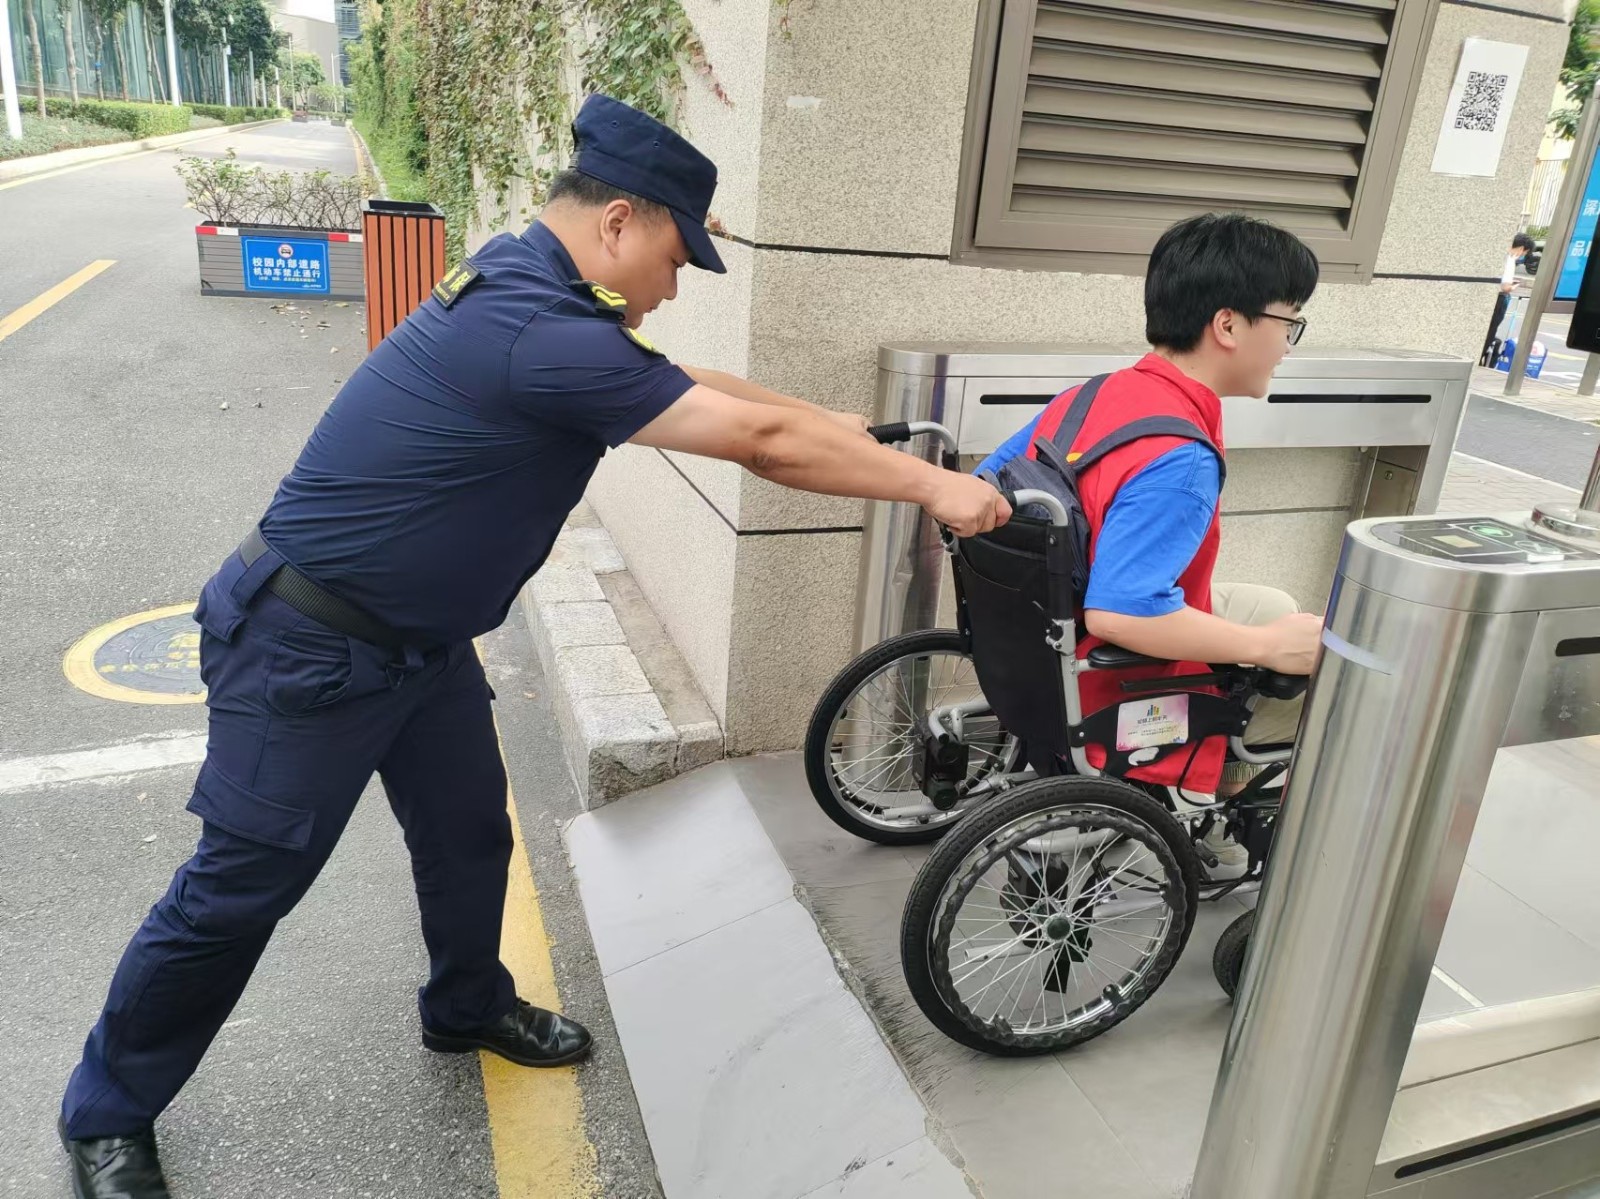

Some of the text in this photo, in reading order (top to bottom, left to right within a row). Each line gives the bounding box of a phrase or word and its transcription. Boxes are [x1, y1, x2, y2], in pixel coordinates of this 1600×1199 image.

[1582, 199, 1600, 216] 深
[252, 257, 321, 270] 校园内部道路
[253, 268, 321, 278] 机动车禁止通行
